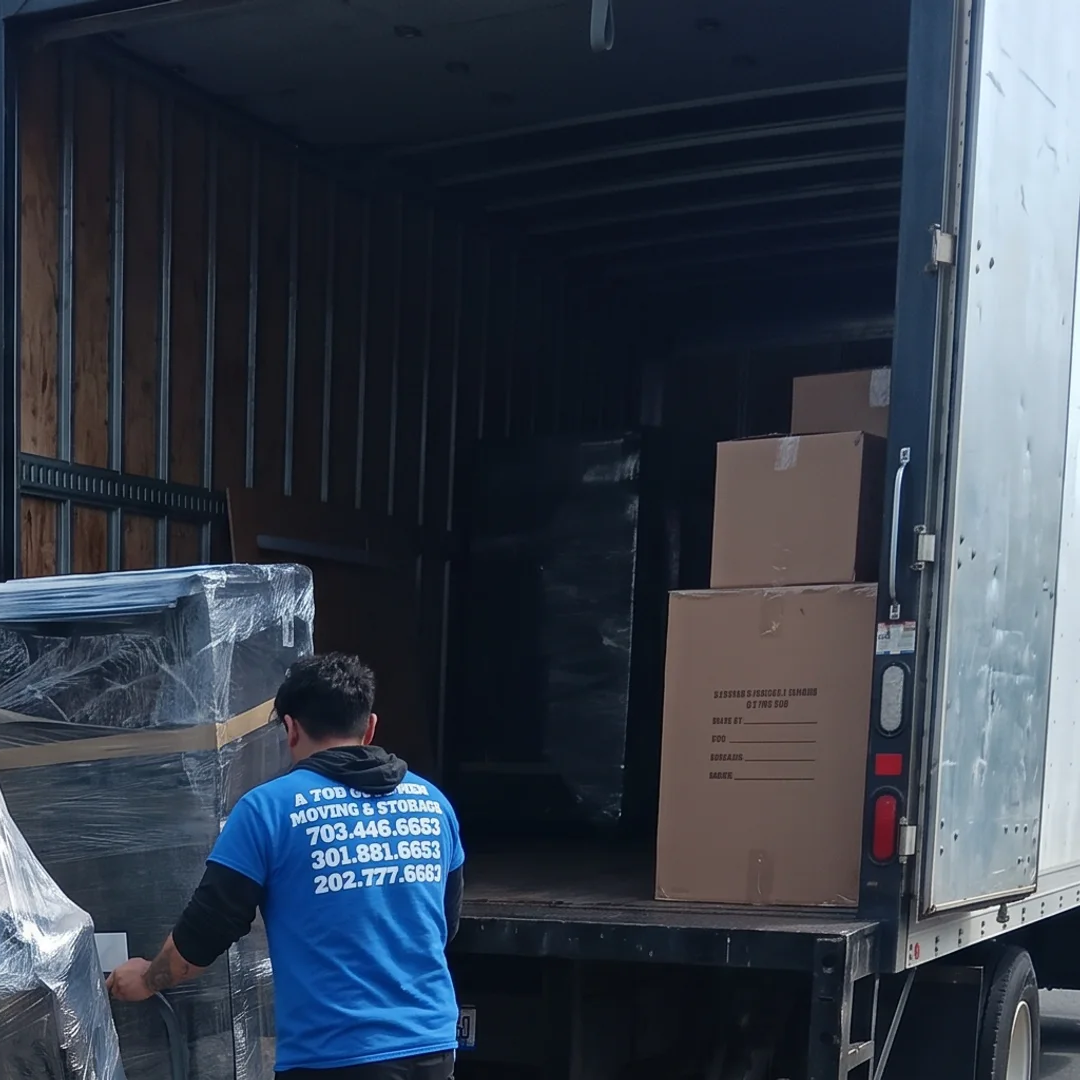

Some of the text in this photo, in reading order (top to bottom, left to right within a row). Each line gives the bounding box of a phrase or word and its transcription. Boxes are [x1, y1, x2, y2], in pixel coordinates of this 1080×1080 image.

[294, 793, 308, 807] A
[289, 802, 360, 828] MOVING
[362, 802, 375, 816] &
[305, 817, 442, 846] 703.446.6653
[310, 840, 442, 870] 301.881.6653
